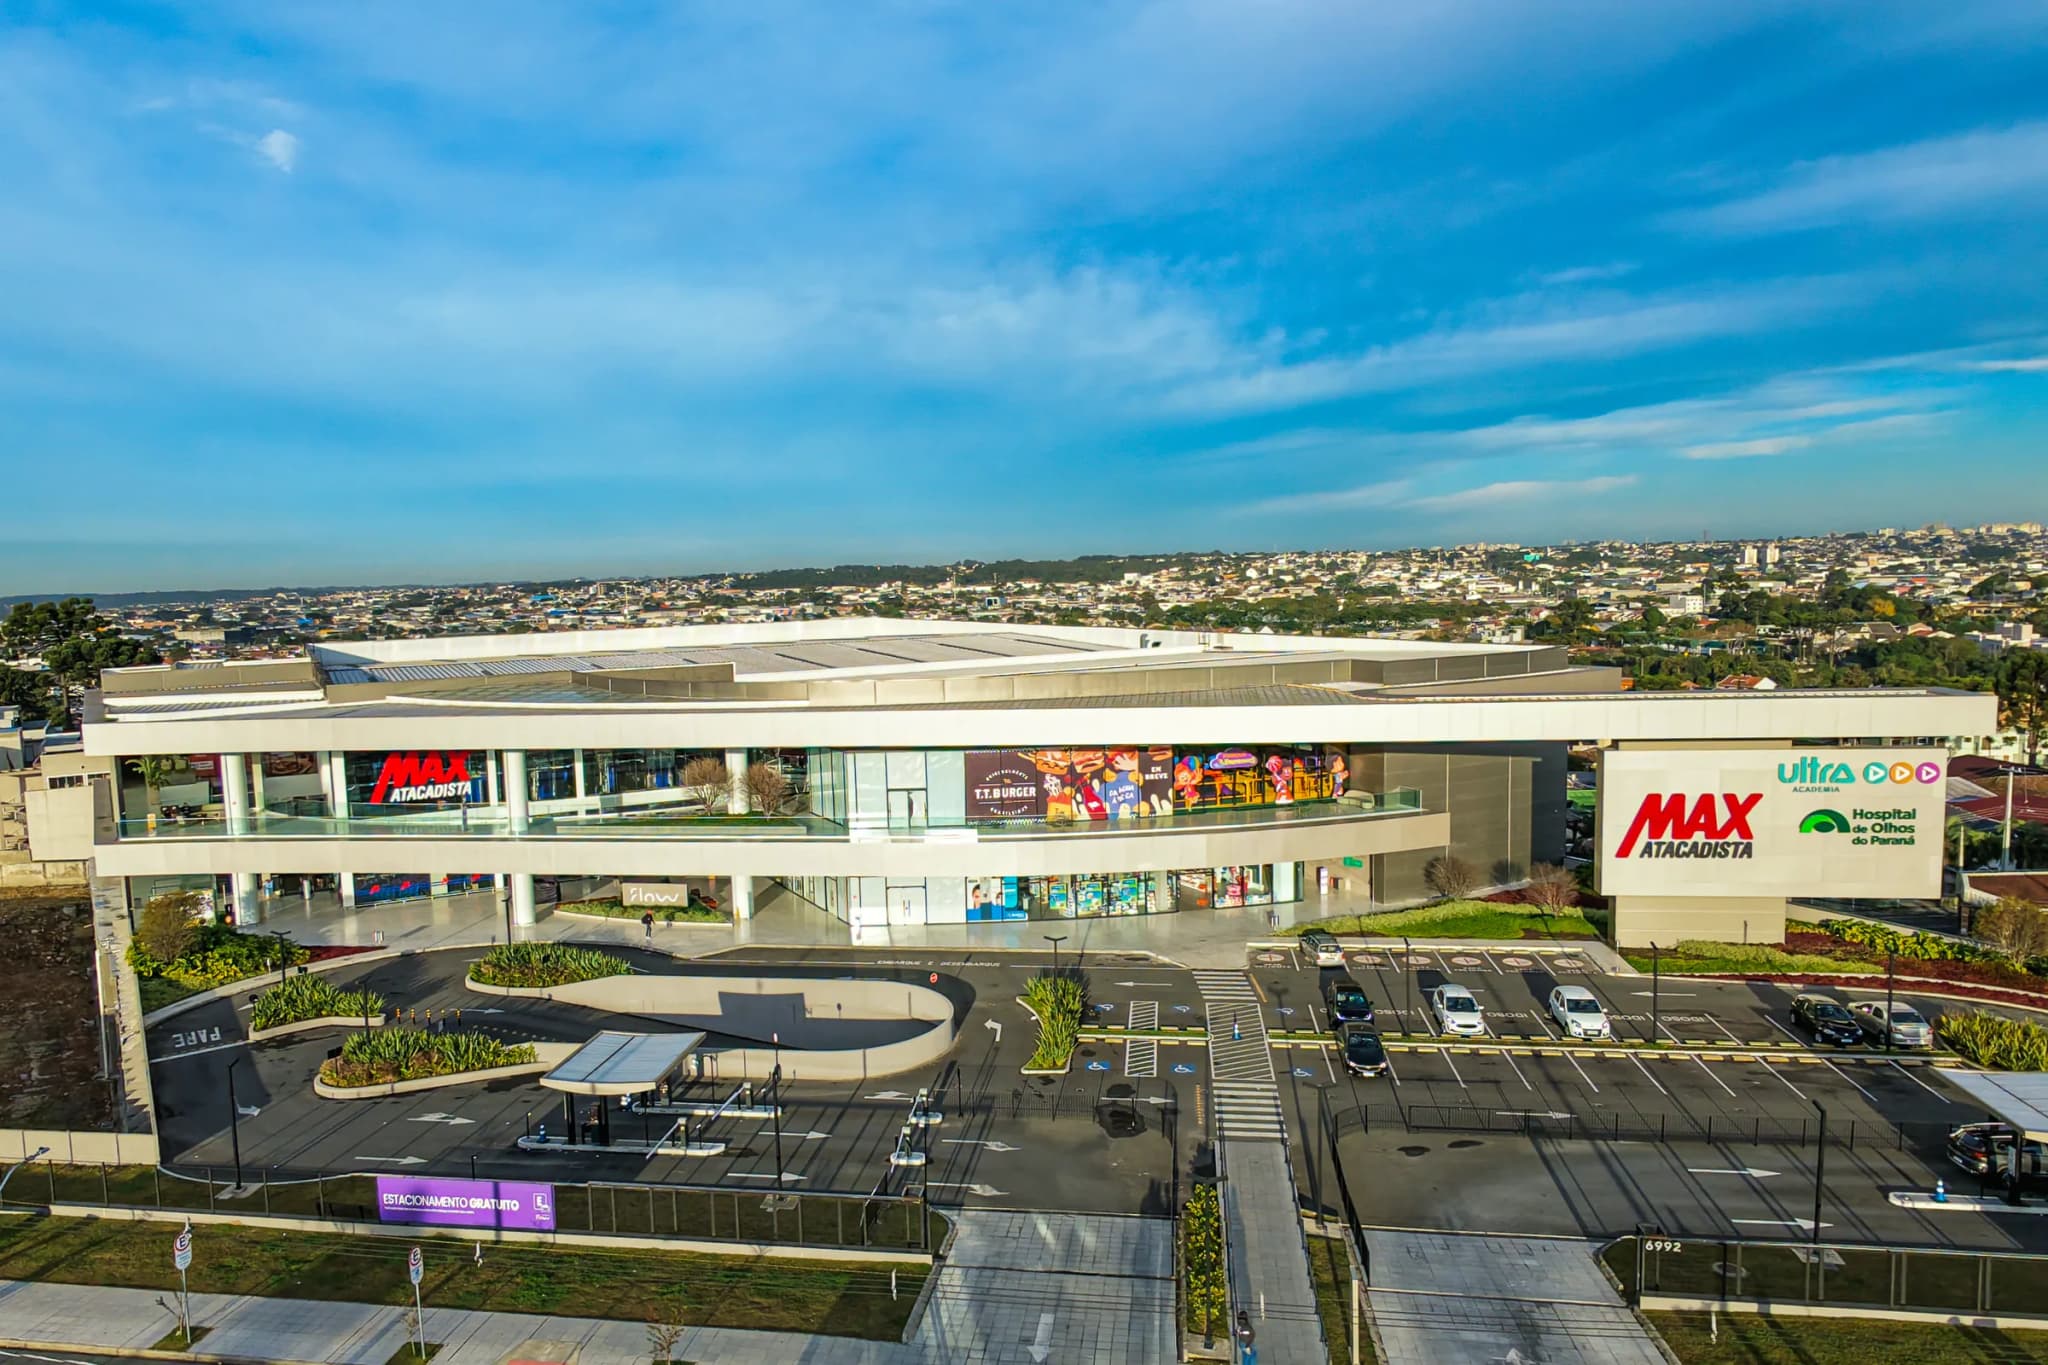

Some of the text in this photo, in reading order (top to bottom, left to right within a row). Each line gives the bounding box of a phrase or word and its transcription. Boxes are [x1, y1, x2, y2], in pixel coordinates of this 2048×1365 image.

[370, 750, 471, 804] MAX
[1777, 757, 1856, 783] ultra
[390, 781, 471, 802] ATACADISTA
[1852, 808, 1916, 821] Hospital
[1615, 793, 1764, 858] MAX
[1852, 822, 1915, 834] de Olhos
[1639, 841, 1753, 858] ATACADISTA
[1852, 835, 1915, 846] do Paraná
[172, 1026, 221, 1048] PARE
[383, 1193, 468, 1208] ESTACIONAMENTO
[469, 1197, 520, 1212] GRATUITO
[1645, 1240, 1681, 1253] 6992
